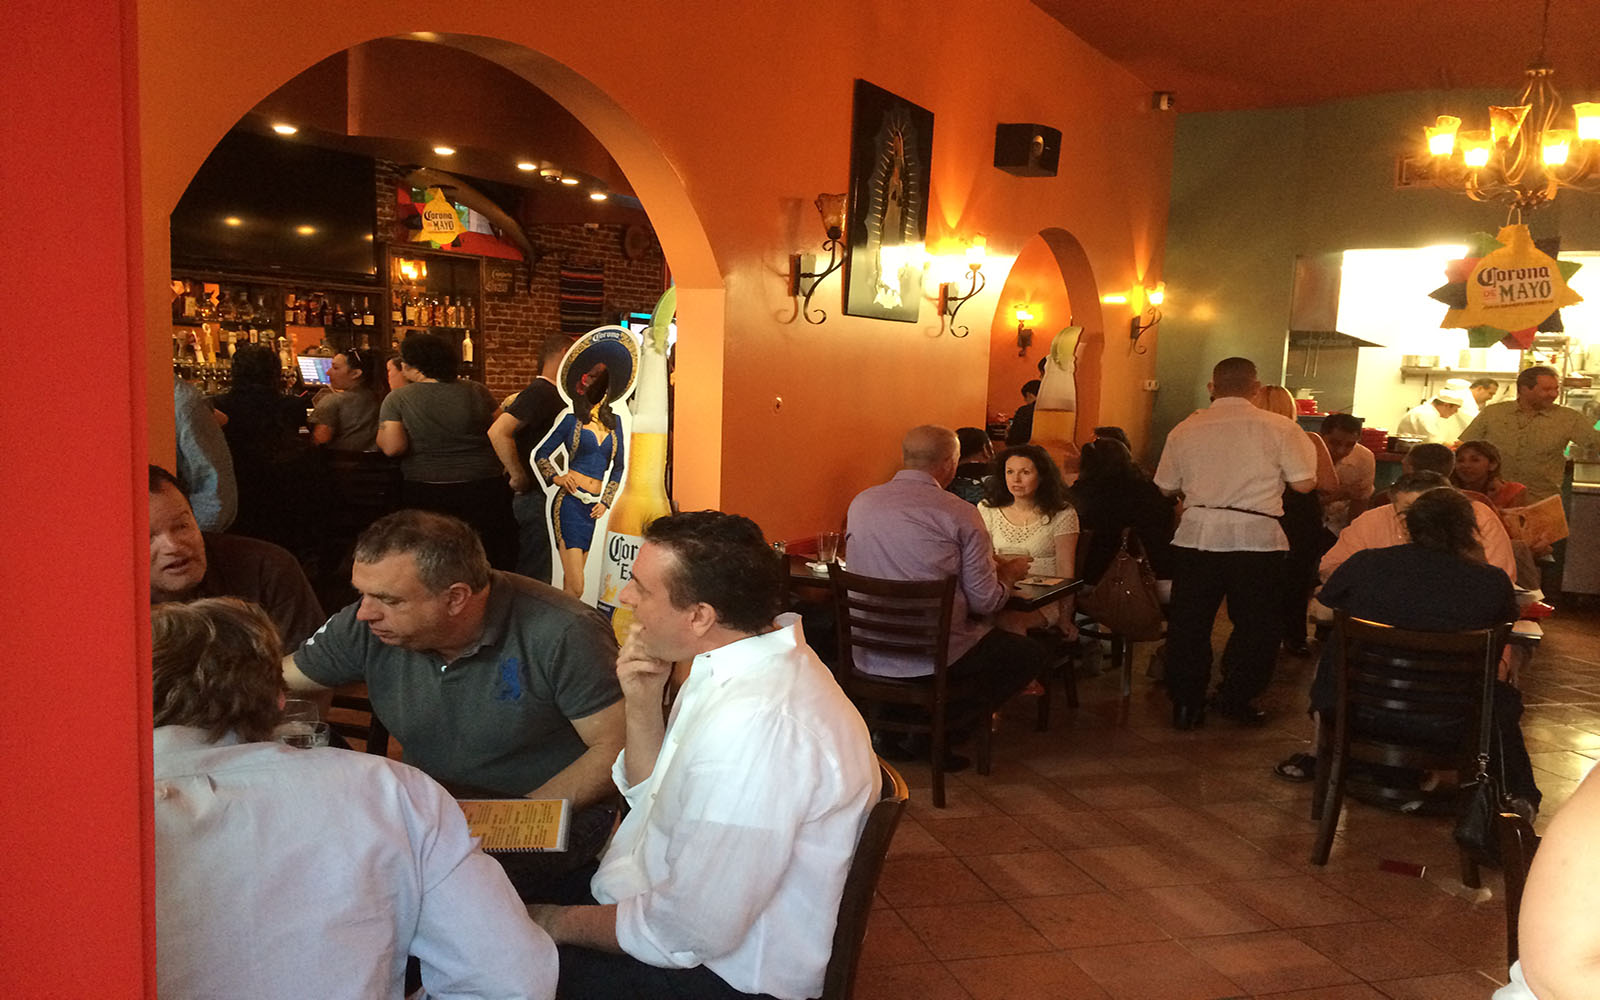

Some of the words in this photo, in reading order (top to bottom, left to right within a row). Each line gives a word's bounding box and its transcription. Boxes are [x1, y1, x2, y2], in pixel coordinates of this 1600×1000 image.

[433, 221, 454, 231] MAYO
[1477, 267, 1550, 288] Corona
[1499, 280, 1552, 302] MAYO
[592, 331, 620, 342] Corona
